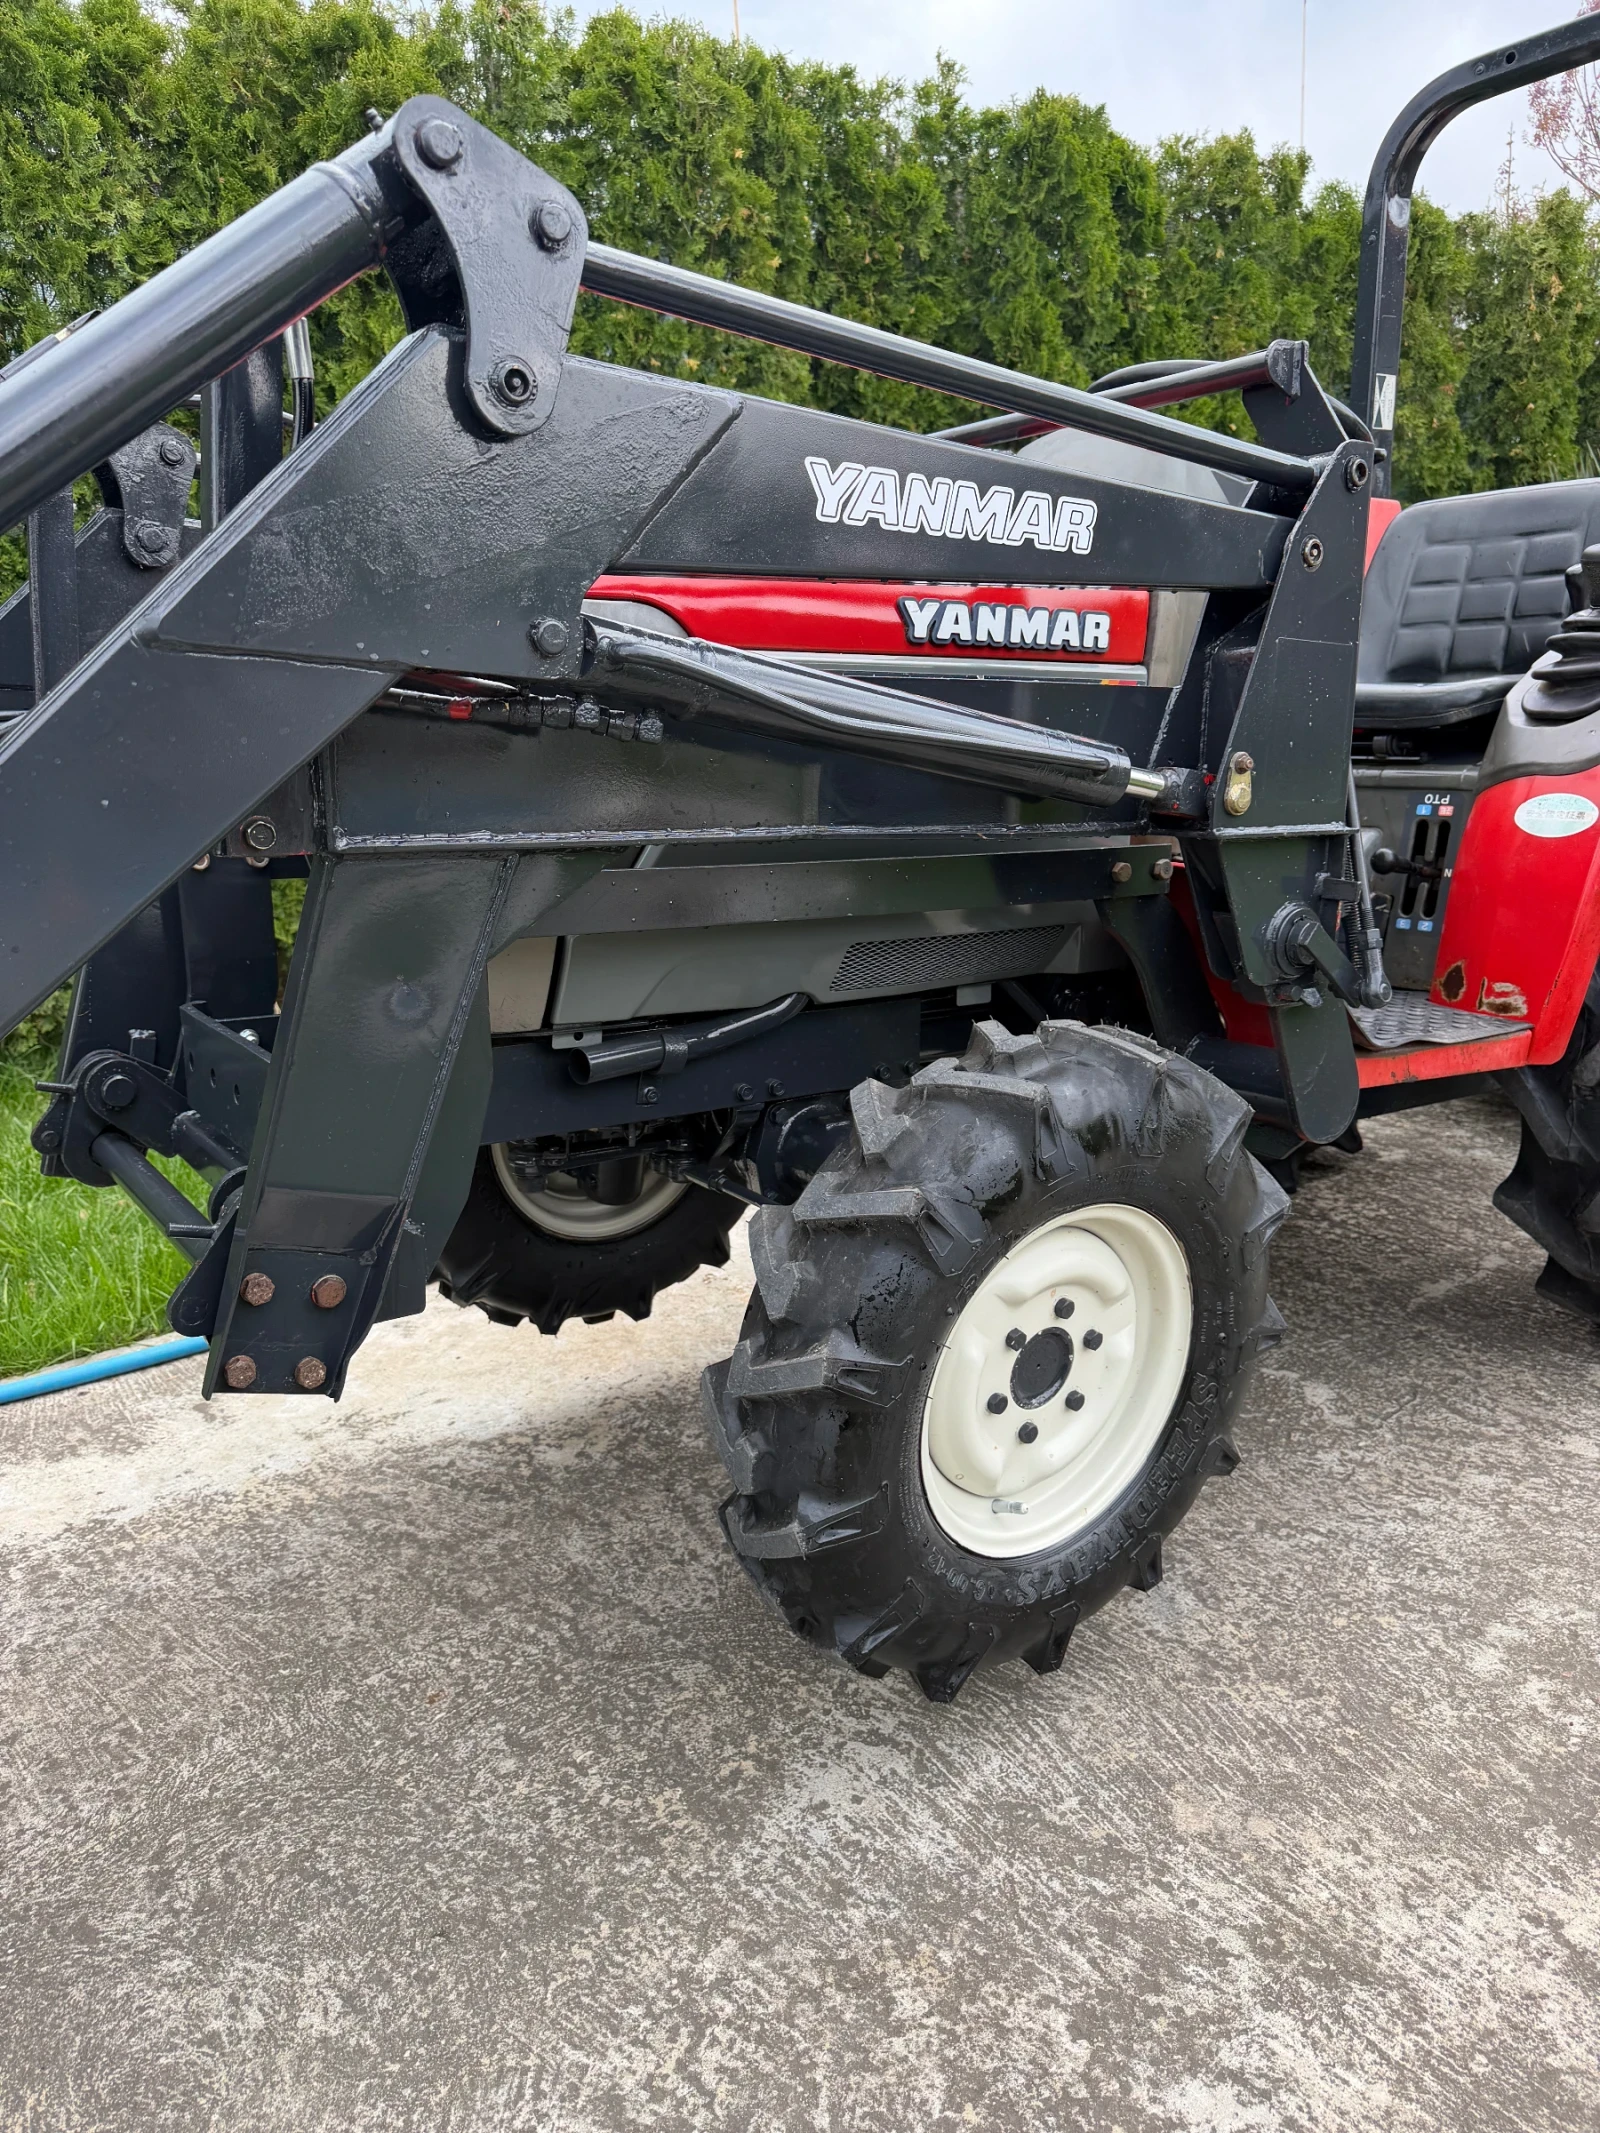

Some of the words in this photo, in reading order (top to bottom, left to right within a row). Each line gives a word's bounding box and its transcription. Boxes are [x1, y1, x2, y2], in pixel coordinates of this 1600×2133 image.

[804, 456, 1098, 555] YANMAR
[899, 597, 1111, 652] YANMAR
[1424, 793, 1450, 805] PTO
[1016, 1372, 1219, 1606] SPEEDWAYS
